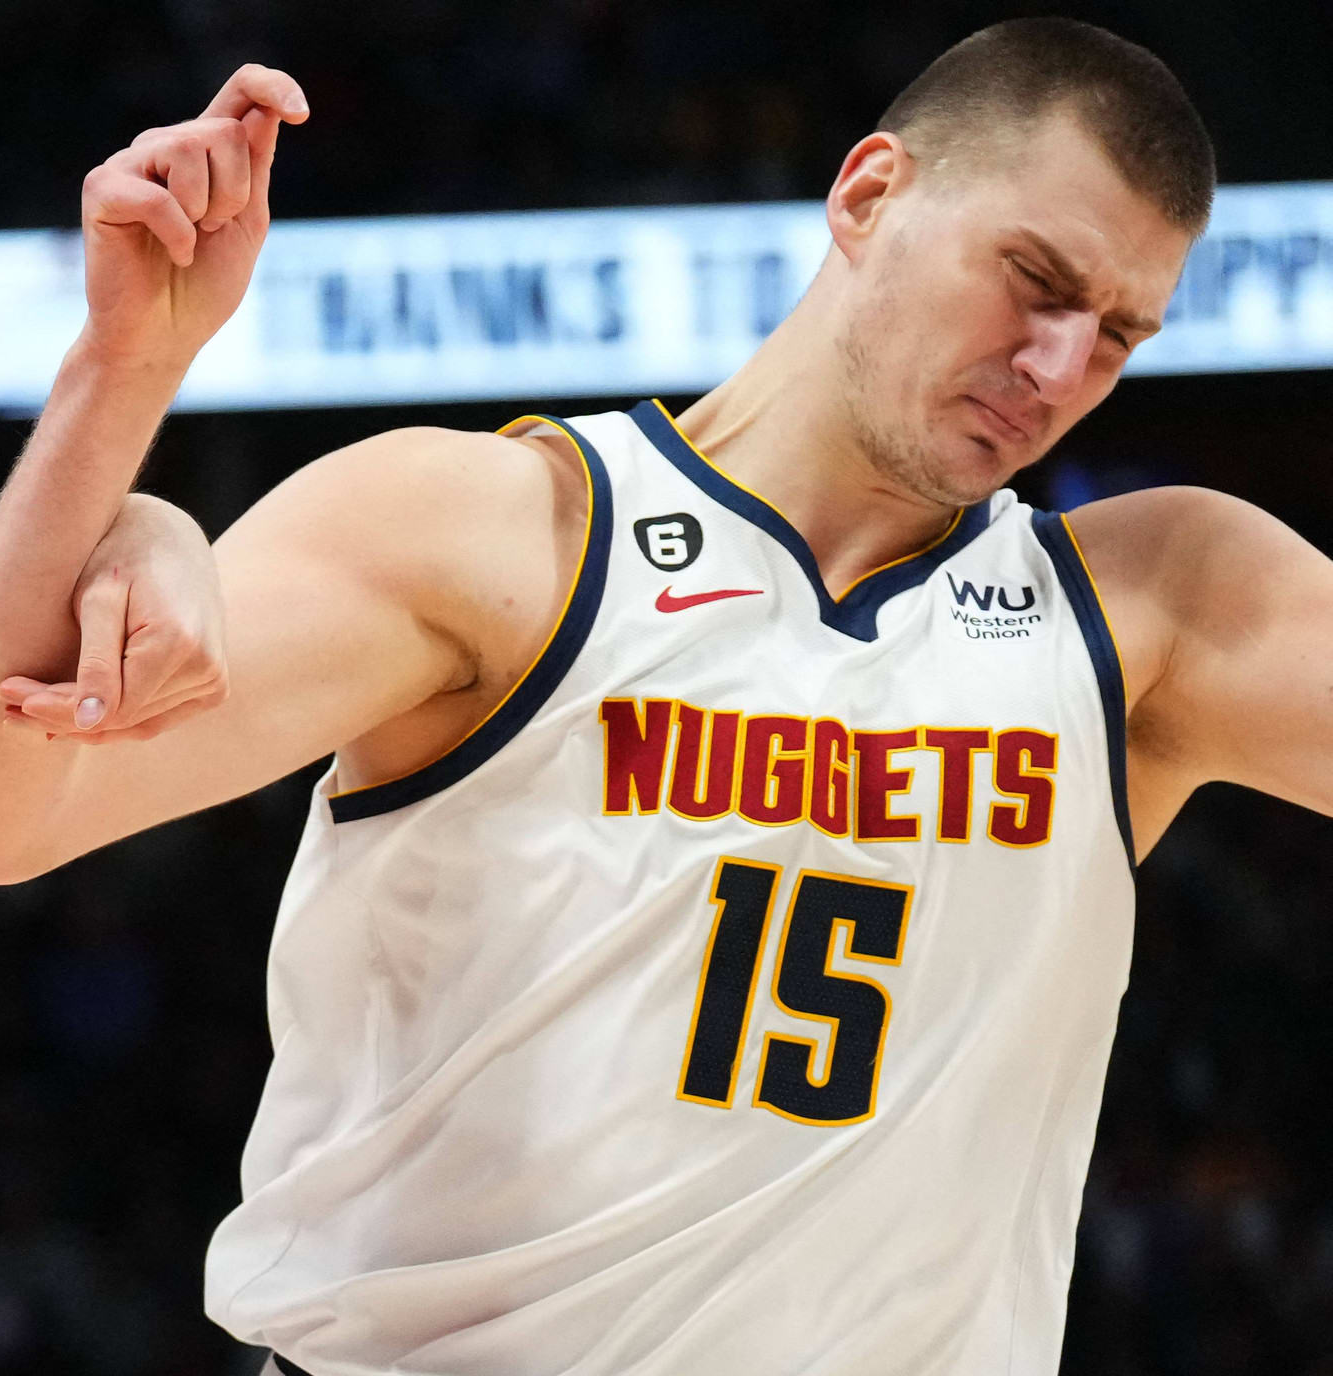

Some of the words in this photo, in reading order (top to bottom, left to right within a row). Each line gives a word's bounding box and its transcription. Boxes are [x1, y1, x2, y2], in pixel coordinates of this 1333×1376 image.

[644, 521, 688, 566] 6
[945, 570, 1036, 612] WU
[950, 605, 1042, 627] Western
[965, 626, 1031, 639] Union
[598, 697, 1059, 849] NUGGETS
[675, 855, 915, 1127] 15
